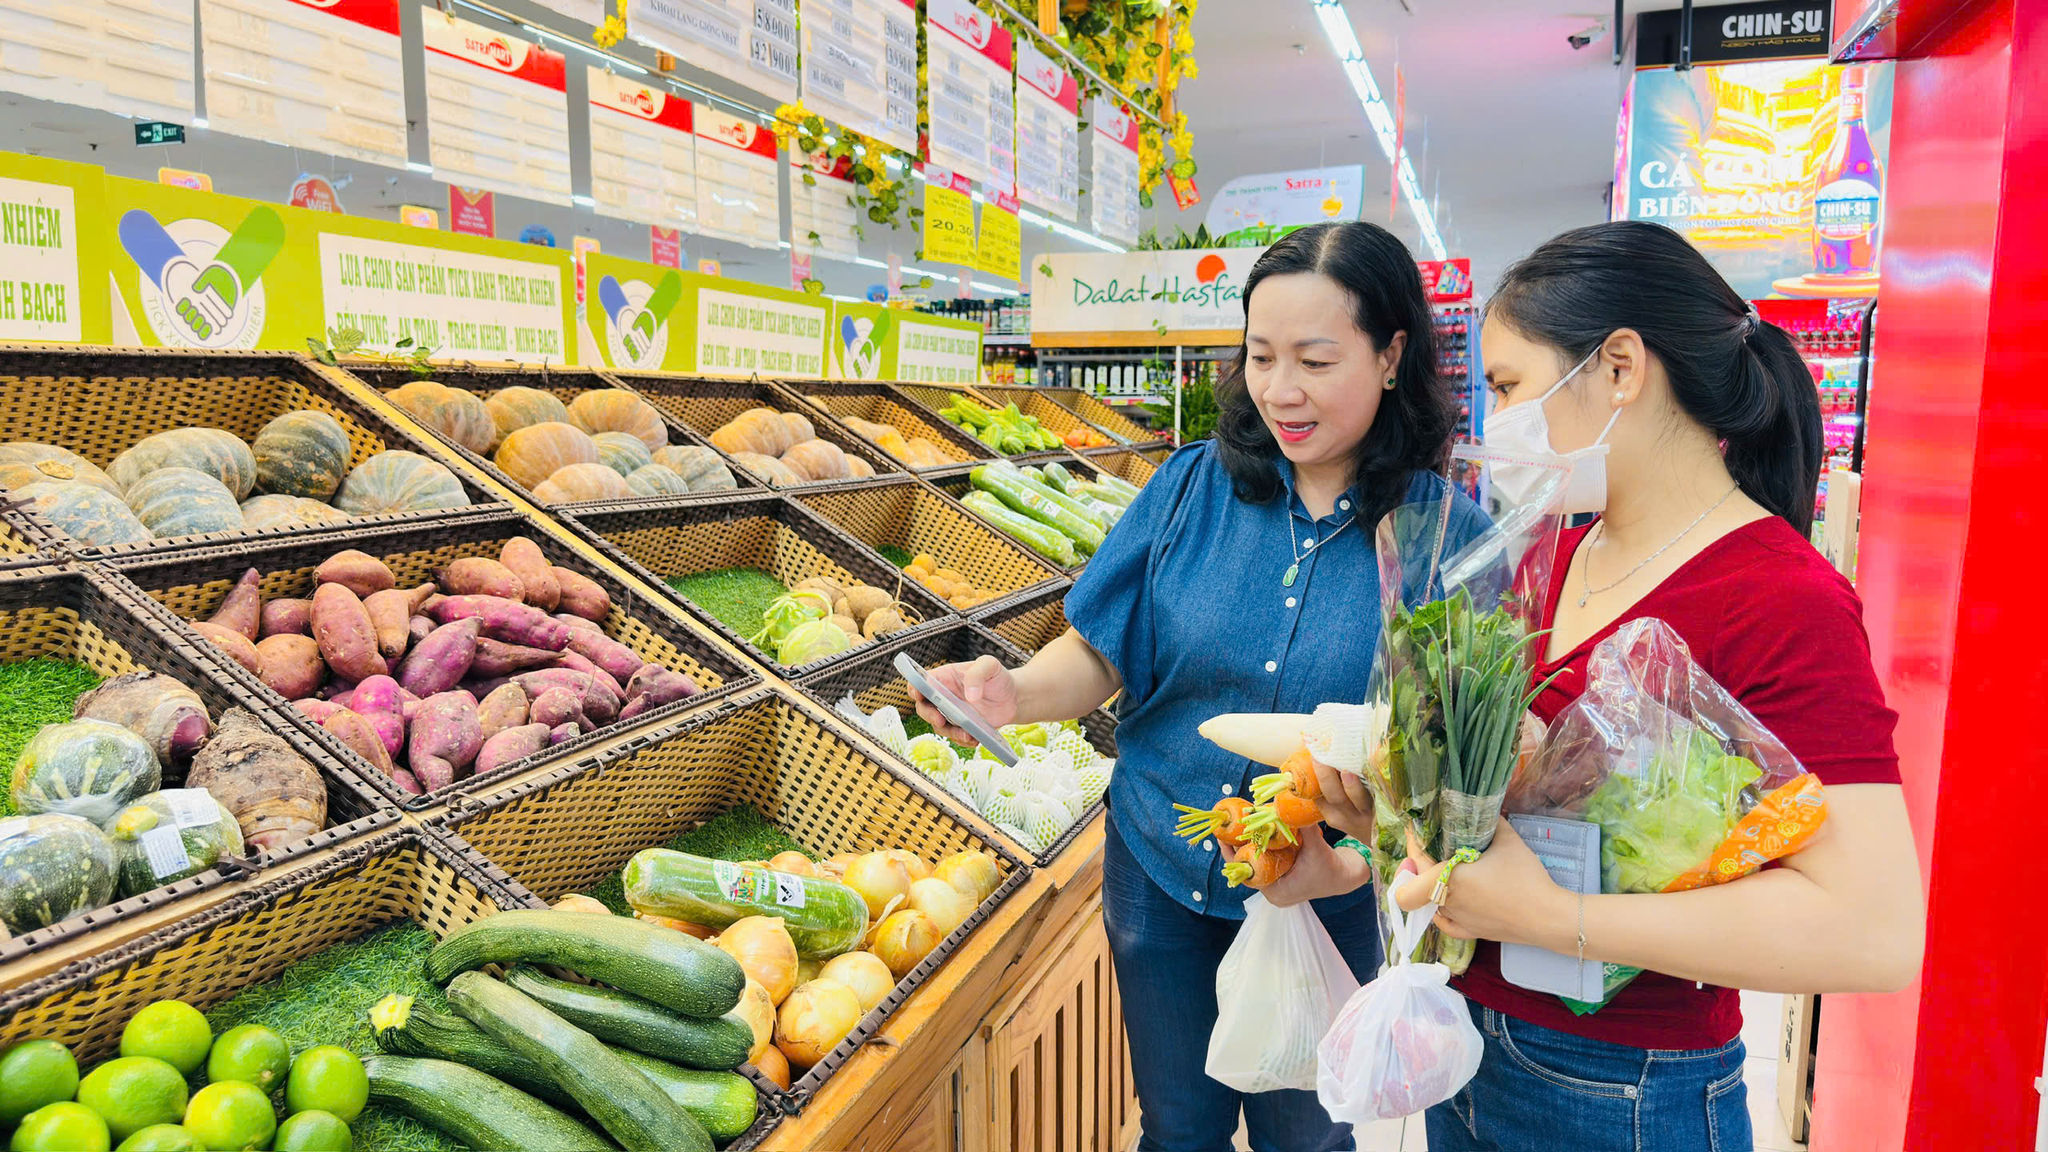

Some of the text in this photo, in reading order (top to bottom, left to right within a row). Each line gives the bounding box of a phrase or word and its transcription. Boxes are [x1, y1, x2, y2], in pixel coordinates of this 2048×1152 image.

[1722, 10, 1824, 38] CHIN-SU
[465, 38, 511, 65] SATRAMART
[163, 127, 177, 137] EXIT
[1285, 177, 1322, 191] Satra
[1640, 152, 1695, 189] CÁ
[1820, 202, 1871, 217] CHIN-SU
[1, 197, 62, 256] NHIỆM
[364, 255, 393, 296] CHỌN
[395, 252, 416, 292] SẢN
[418, 253, 446, 295] PHẨM
[448, 268, 471, 298] TICK
[472, 270, 496, 301] XANH
[498, 270, 527, 304] TRÁCH
[529, 275, 556, 311] NHIỆM
[1073, 275, 1149, 306] Dalat
[21, 281, 67, 331] BẠCH
[398, 317, 411, 342] AN
[448, 320, 477, 350] TRÁCH
[480, 318, 507, 356] NHIỆM
[514, 326, 537, 353] MINH
[538, 327, 559, 360] BẠCH
